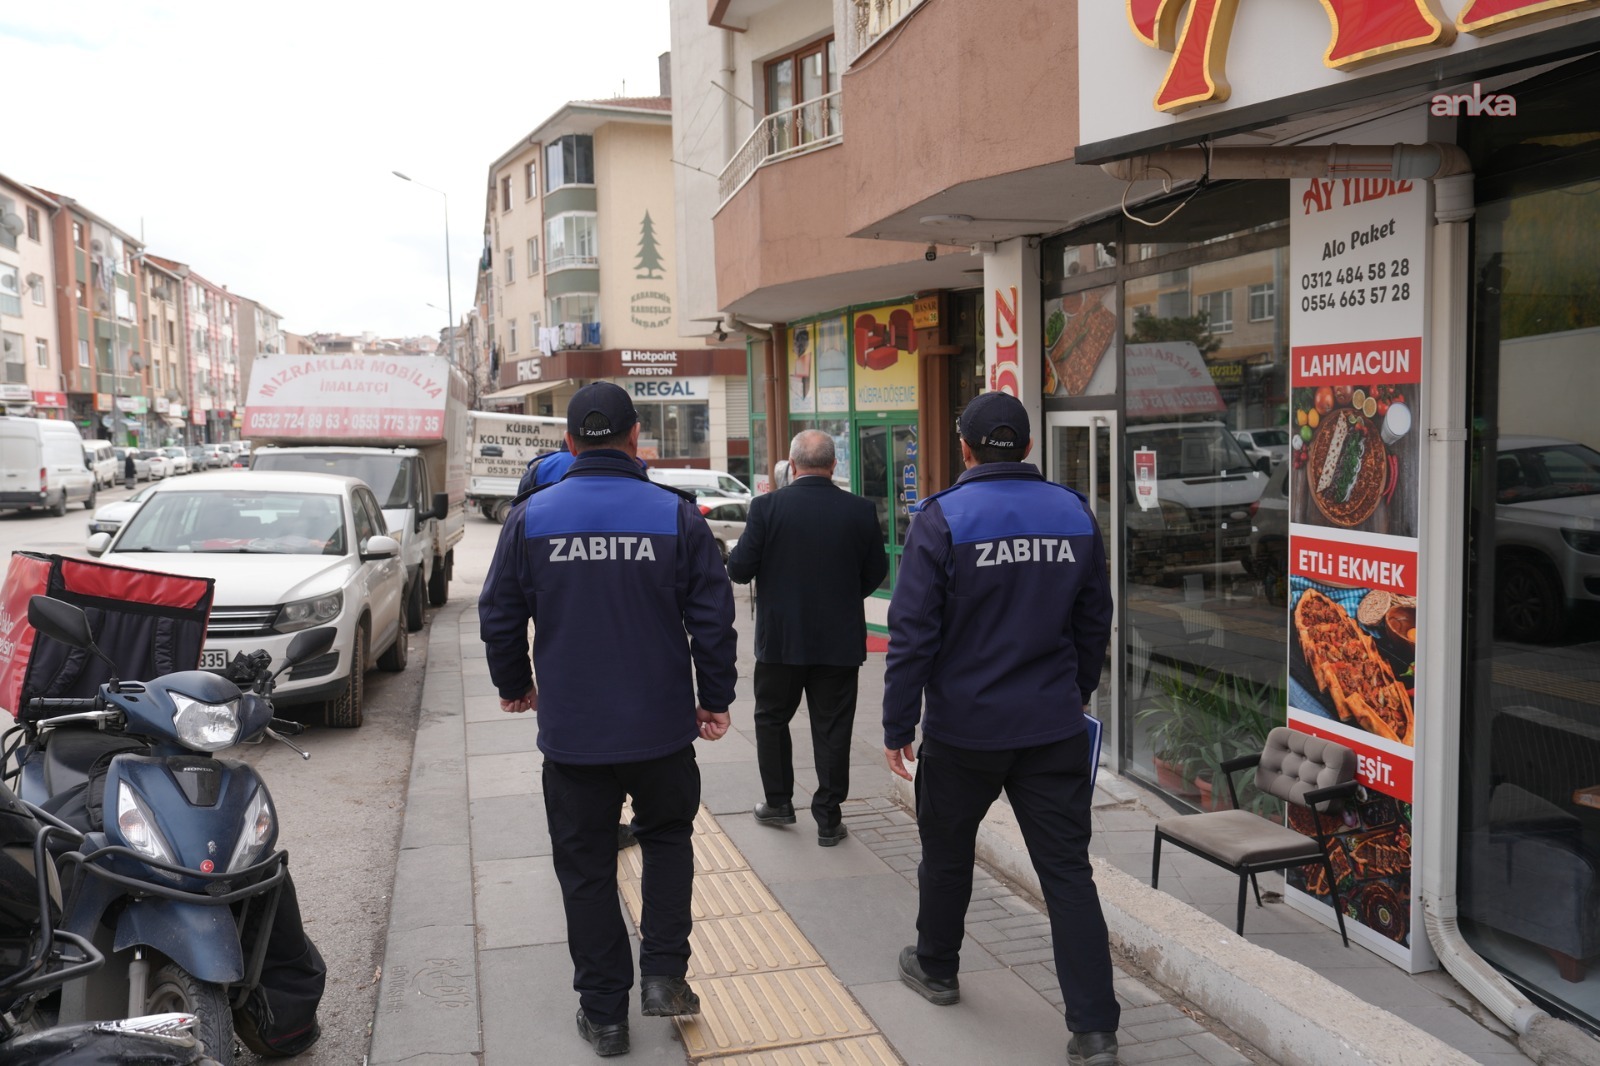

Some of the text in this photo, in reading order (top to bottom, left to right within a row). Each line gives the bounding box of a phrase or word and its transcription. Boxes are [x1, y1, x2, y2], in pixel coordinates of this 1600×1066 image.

[1302, 178, 1336, 215] AY
[1322, 218, 1396, 261] Alo Paket
[1301, 258, 1409, 290] 0312 484 58 28
[1301, 282, 1410, 312] 0554 663 57 28
[633, 351, 678, 363] Hotpoint
[1300, 349, 1410, 377] LAHMACUN
[259, 358, 443, 398] MIZRAKLAR MOBİLYA
[627, 367, 673, 376] ARISTON
[634, 381, 695, 396] REGAL
[251, 413, 439, 432] 0532 724 89 63 0553 775 37 35
[506, 422, 541, 434] KÜBRA
[480, 434, 521, 446] KOLTUK
[487, 466, 509, 474] 0535
[549, 536, 656, 562] ZABITA
[975, 538, 1076, 567] ZABITA
[1338, 554, 1405, 588] EKMEK
[1356, 754, 1395, 787] EŞİT.
